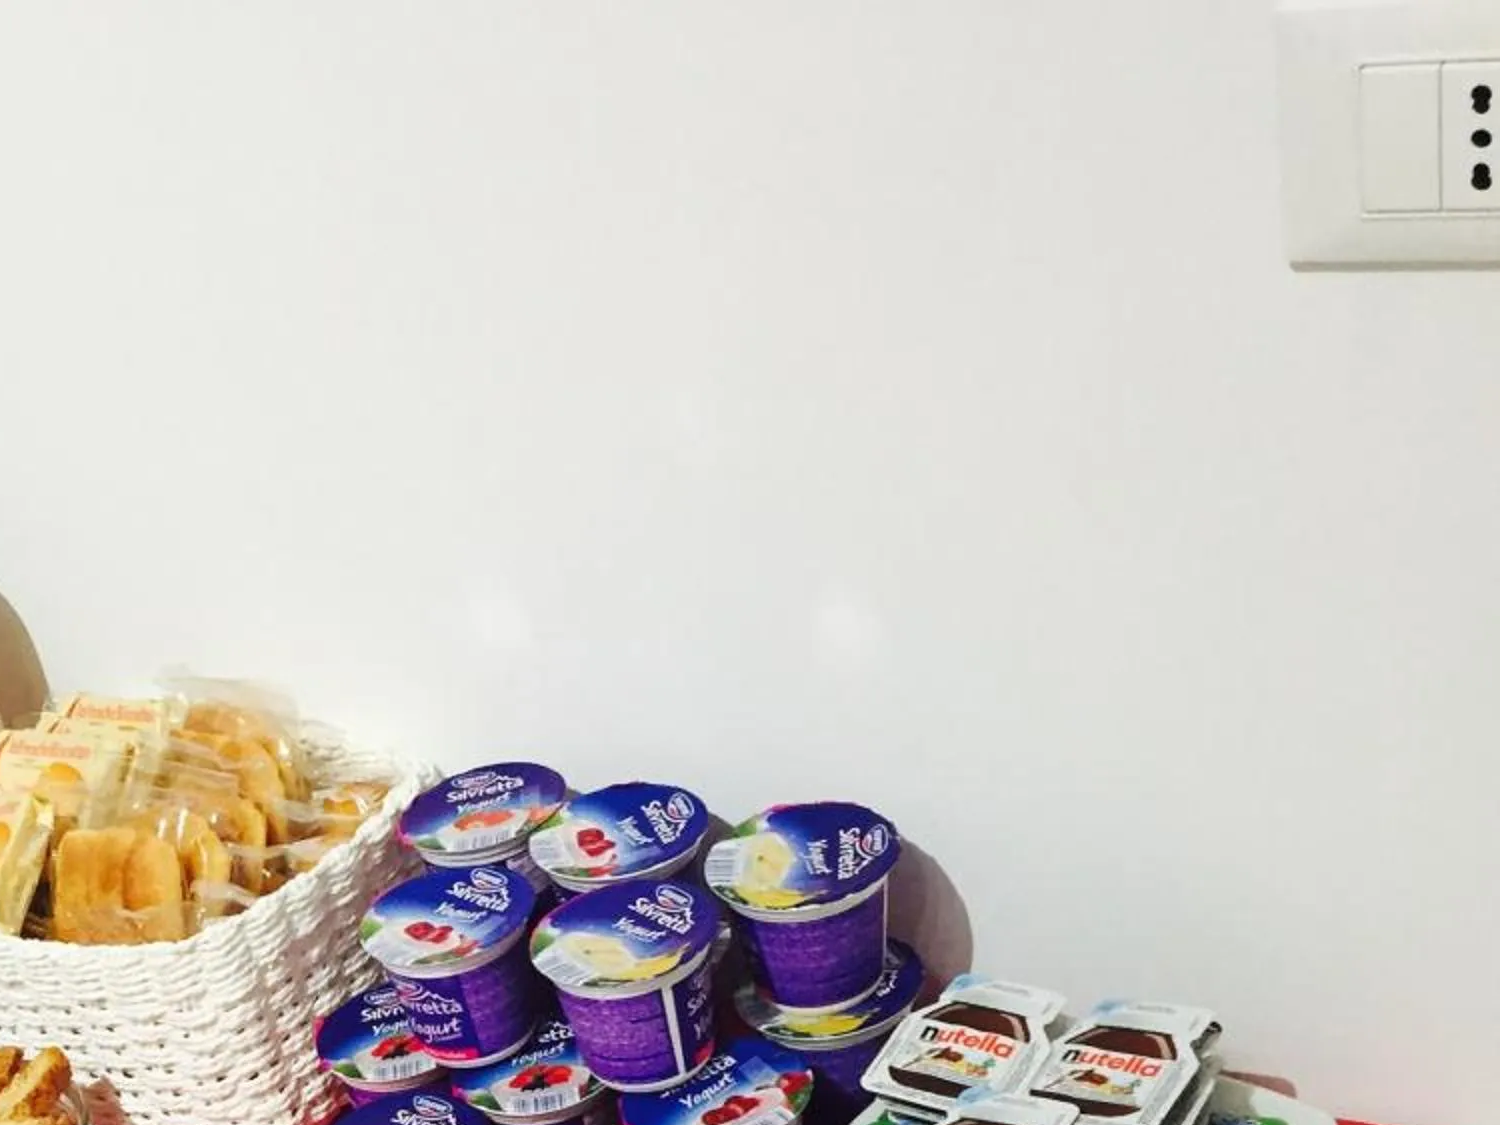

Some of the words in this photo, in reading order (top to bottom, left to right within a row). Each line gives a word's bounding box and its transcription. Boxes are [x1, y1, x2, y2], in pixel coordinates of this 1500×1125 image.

[445, 881, 509, 912] Silvretta
[628, 898, 691, 934] Silvretta
[920, 1025, 1015, 1058] nutella
[1062, 1049, 1161, 1077] nutella
[678, 1073, 735, 1109] Yogurt
